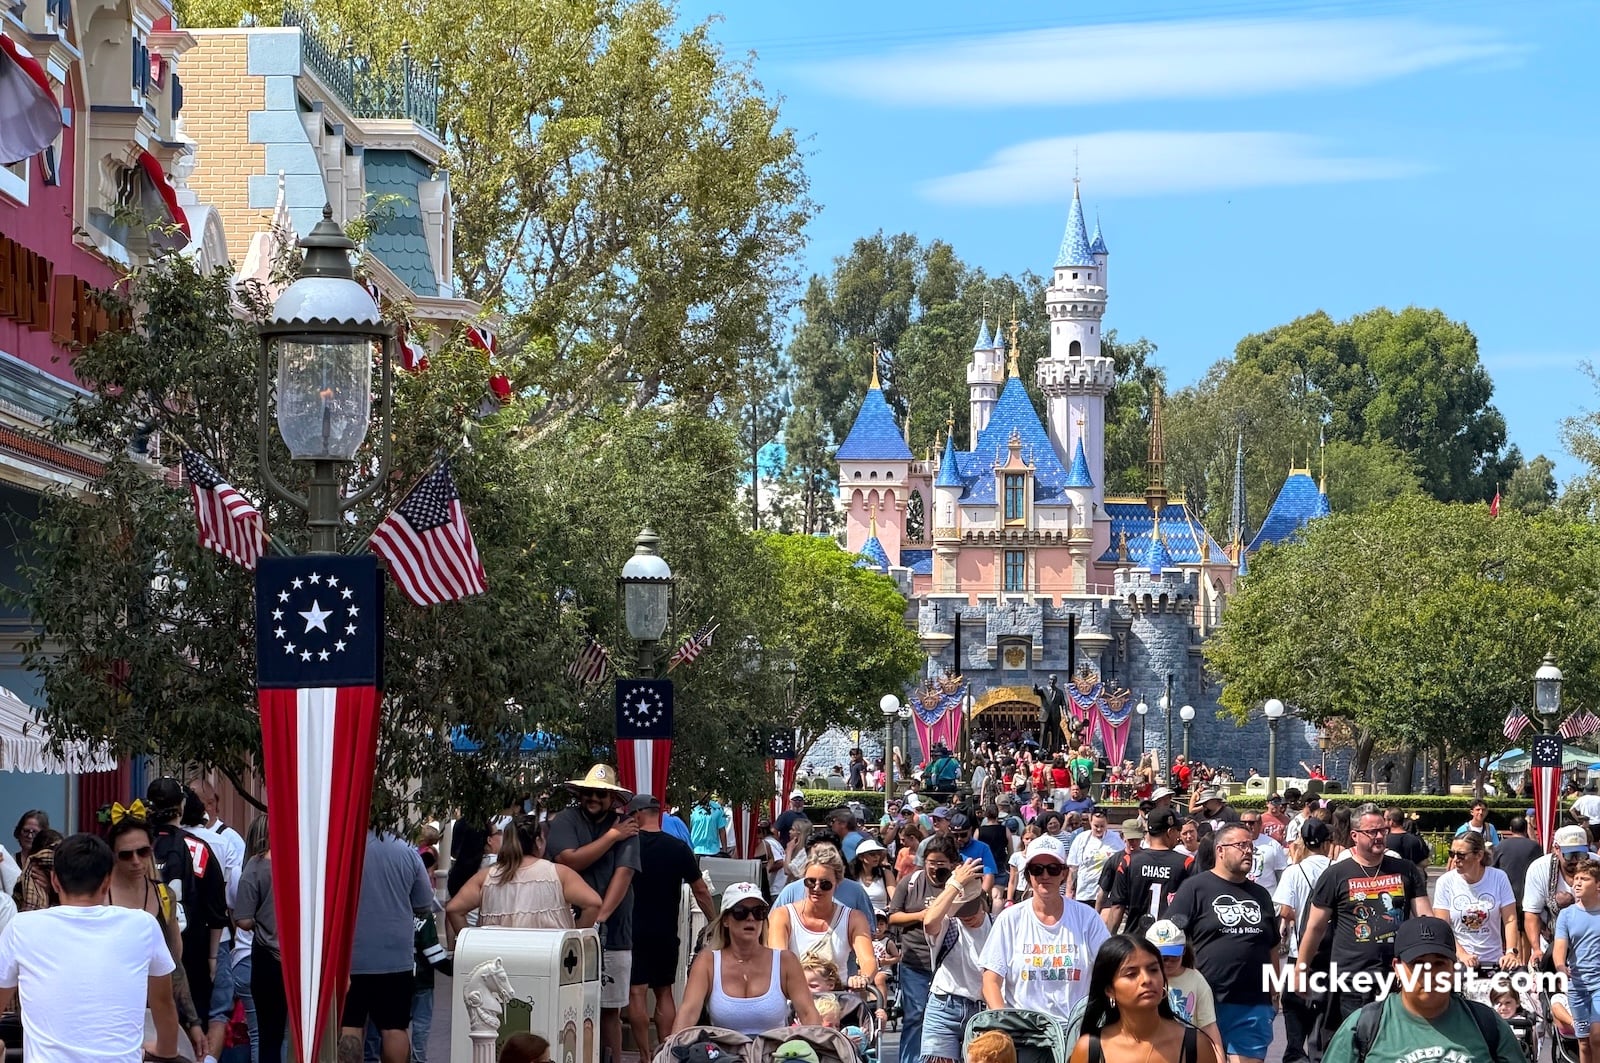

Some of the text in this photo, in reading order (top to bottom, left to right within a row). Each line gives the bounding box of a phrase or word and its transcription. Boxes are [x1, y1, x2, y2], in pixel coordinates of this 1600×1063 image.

[1141, 865, 1171, 879] CHASE
[1349, 875, 1402, 889] HALLOWEEN
[1149, 883, 1162, 921] 1
[1023, 943, 1078, 954] HAPPIEST
[1033, 955, 1073, 967] MAMA
[1021, 968, 1081, 981] ON EARTH
[1404, 1045, 1445, 1063] NEED
